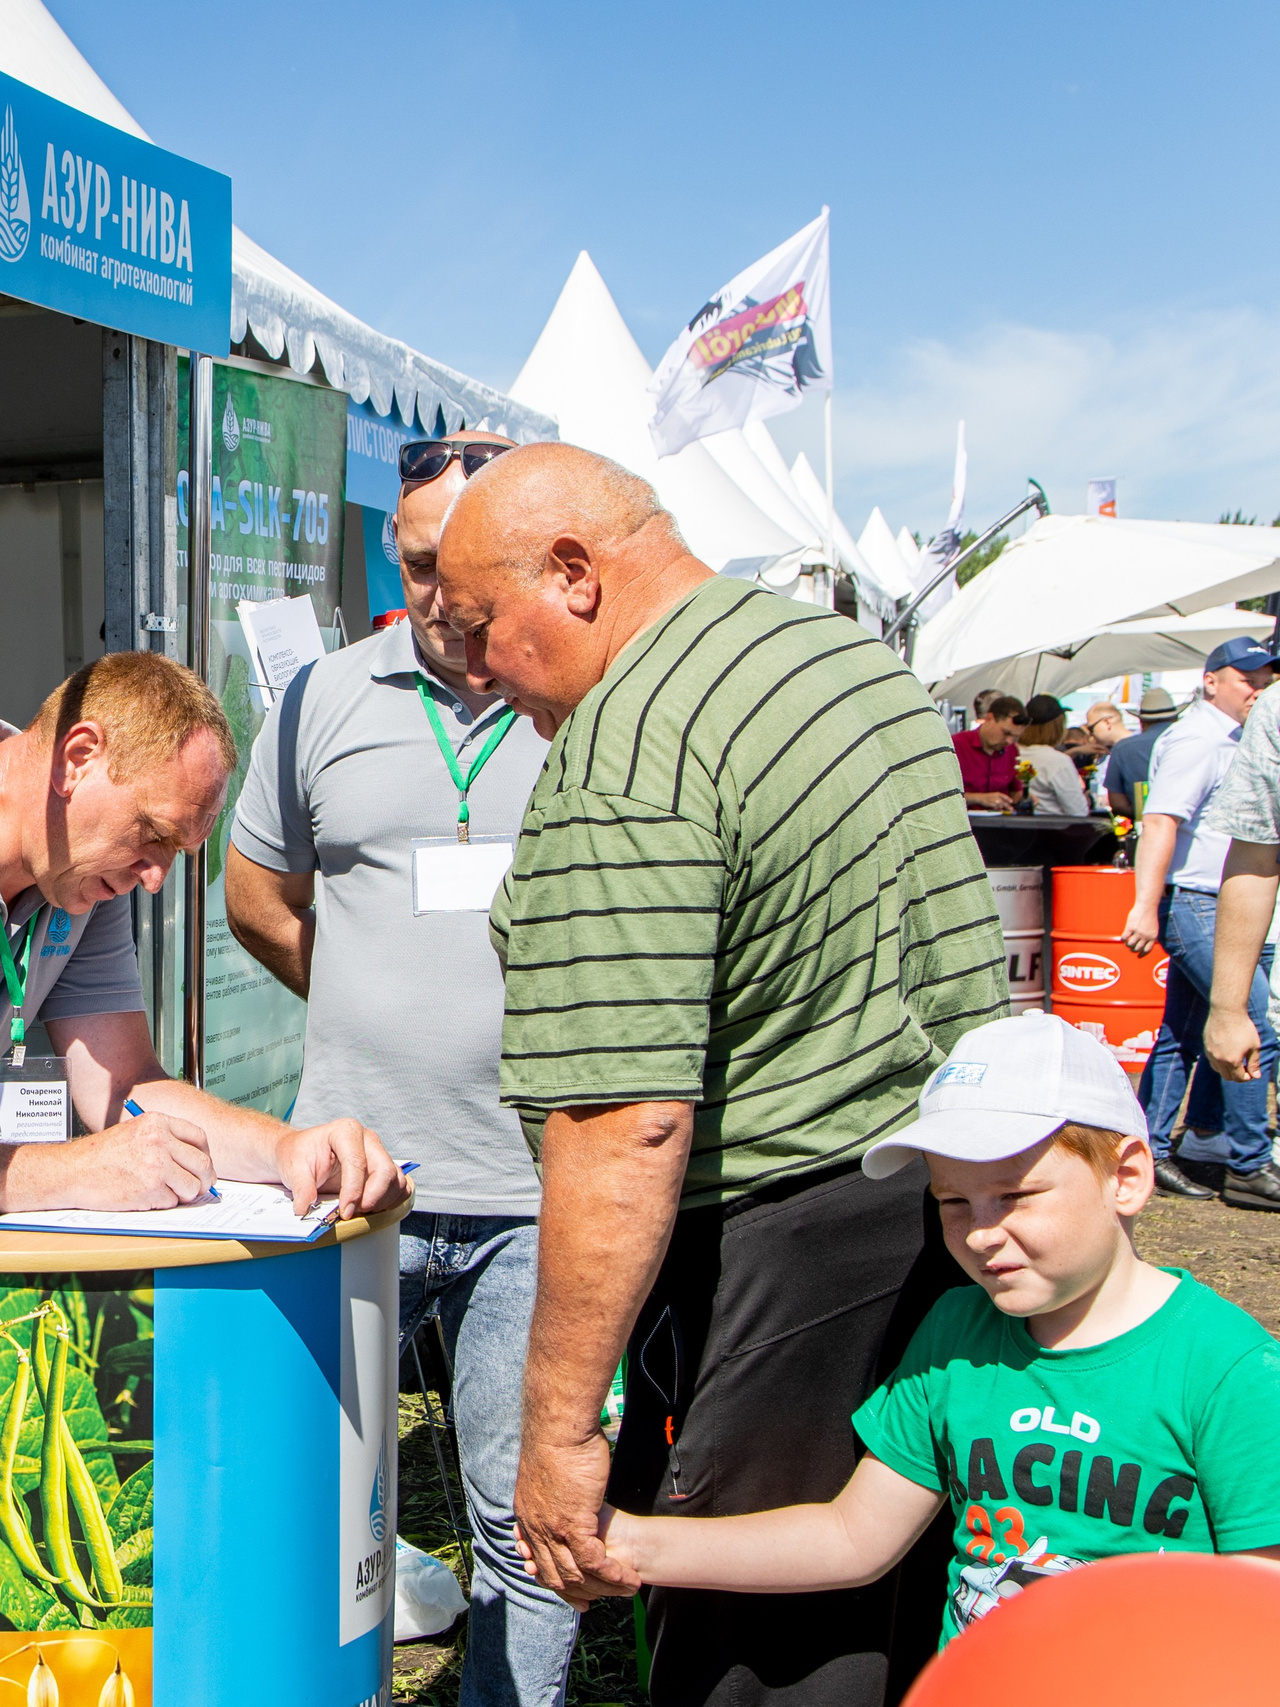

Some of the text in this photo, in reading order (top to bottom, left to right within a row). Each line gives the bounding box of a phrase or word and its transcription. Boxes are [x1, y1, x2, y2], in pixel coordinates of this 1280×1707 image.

[41, 142, 193, 273] АЗУР-НИВА
[40, 233, 193, 306] комбинат агротехнологий
[224, 556, 243, 577] для
[246, 559, 266, 576] всех
[268, 560, 326, 585] пестицидов
[1058, 964, 1117, 981] SINTEC
[20, 1088, 62, 1096] Овчаренко
[1009, 1406, 1101, 1444] OLD
[945, 1436, 1195, 1539] RACING
